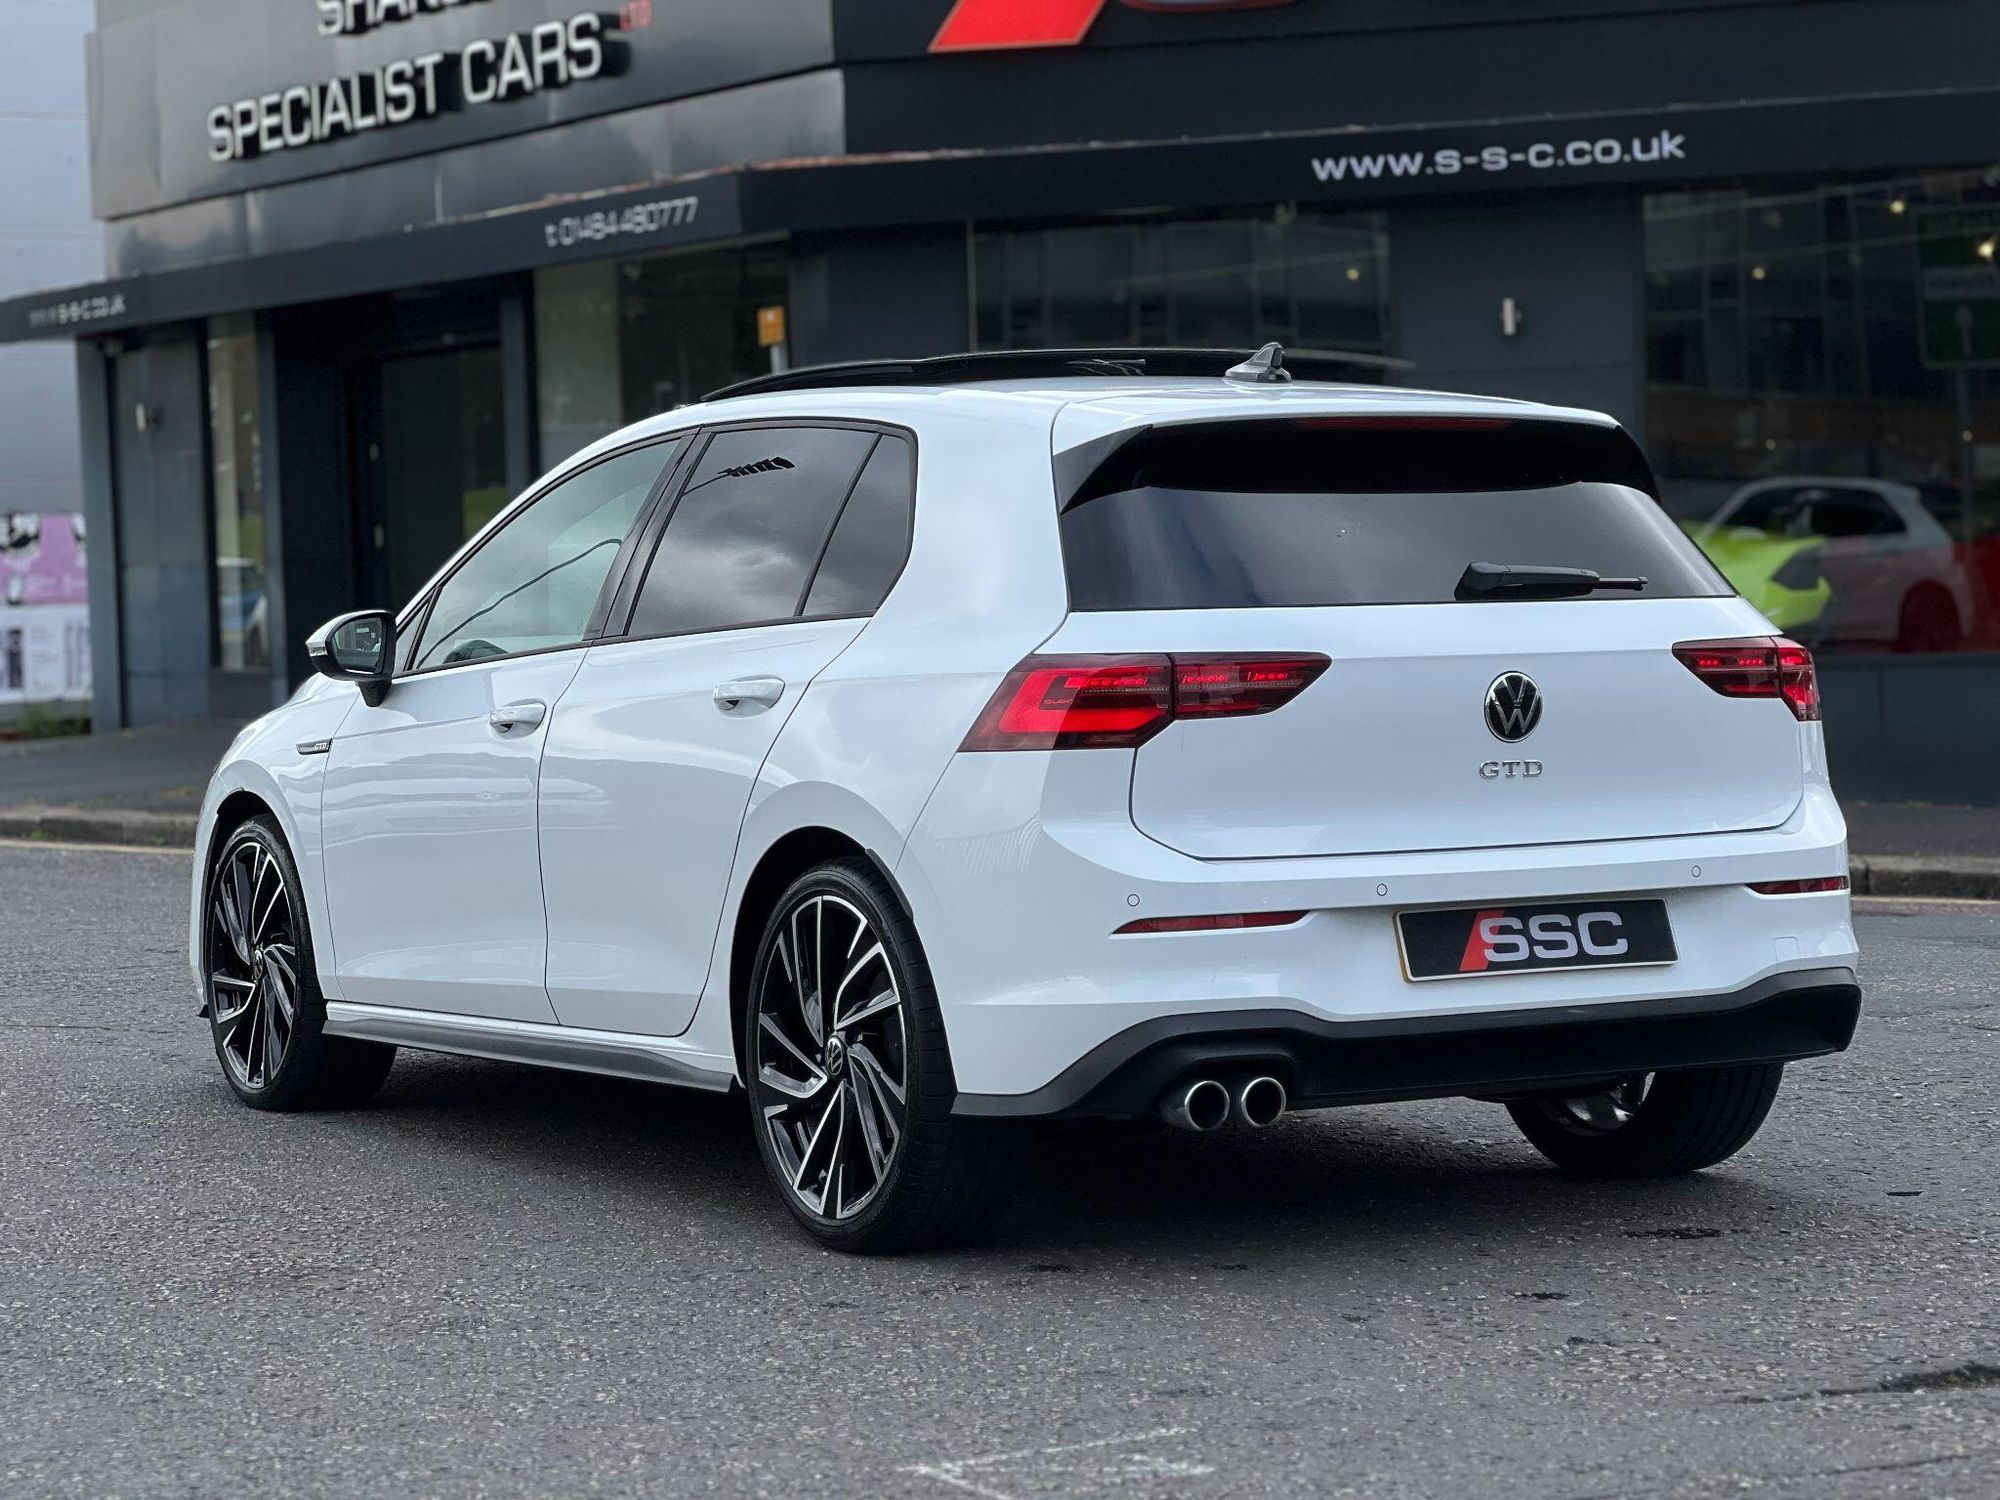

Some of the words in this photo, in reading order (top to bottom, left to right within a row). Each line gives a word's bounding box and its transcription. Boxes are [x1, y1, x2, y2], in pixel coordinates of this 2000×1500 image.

[207, 53, 443, 162] SPECIALIST
[461, 13, 602, 103] CARS
[1311, 130, 1686, 181] www.s-s-c.co.uk
[1479, 759, 1543, 779] GTD
[1479, 911, 1629, 962] SSC
